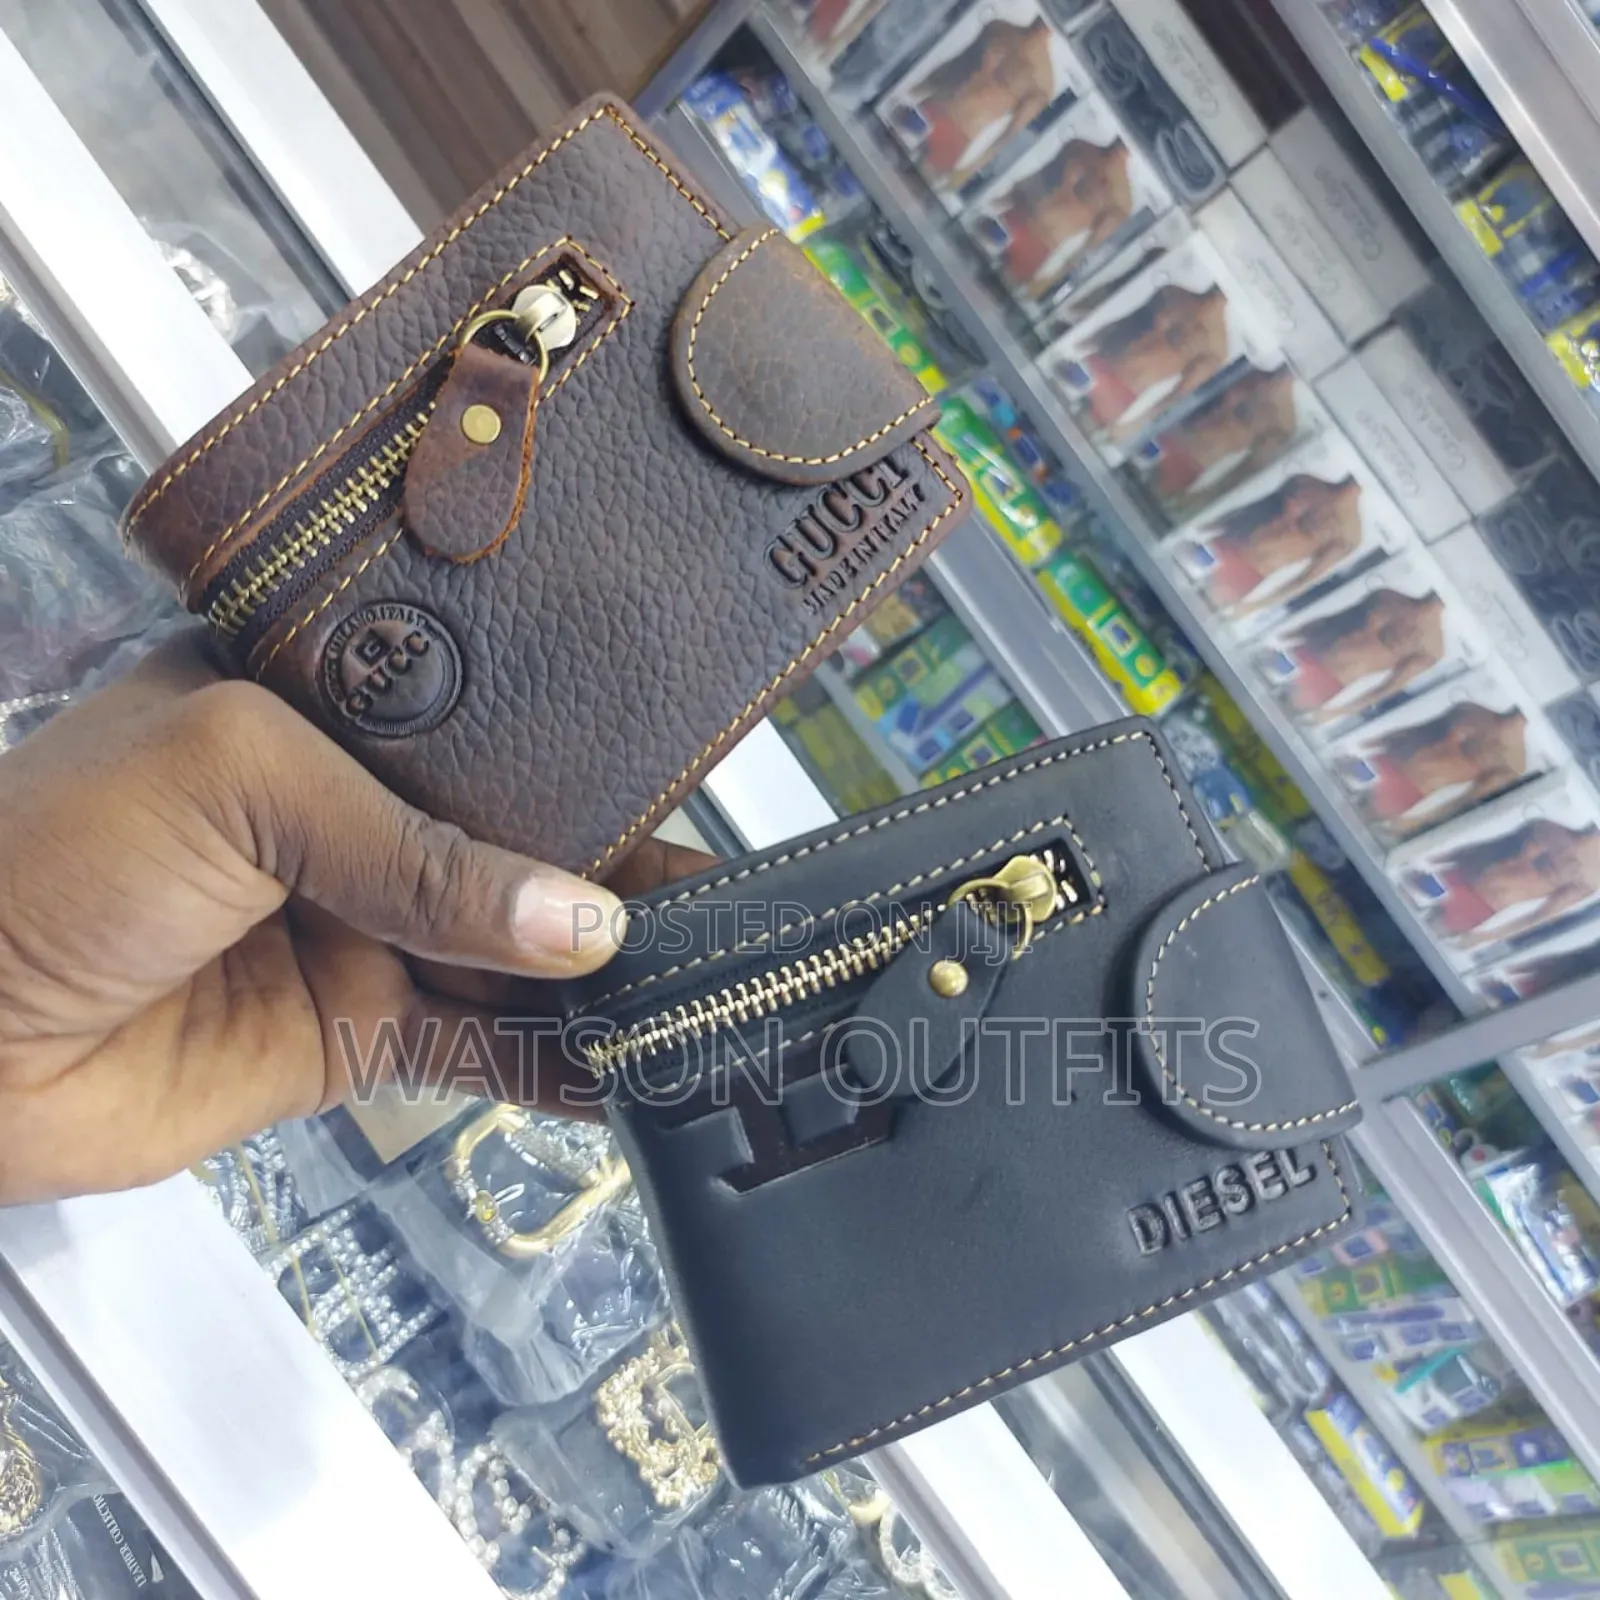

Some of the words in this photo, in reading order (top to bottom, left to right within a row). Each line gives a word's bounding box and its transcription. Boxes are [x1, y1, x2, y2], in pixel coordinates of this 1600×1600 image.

[764, 456, 909, 588] GUCCI
[1127, 1149, 1317, 1255] DIESEL
[93, 1494, 125, 1545] COLLECTIO
[119, 1542, 147, 1588] LEATHER
